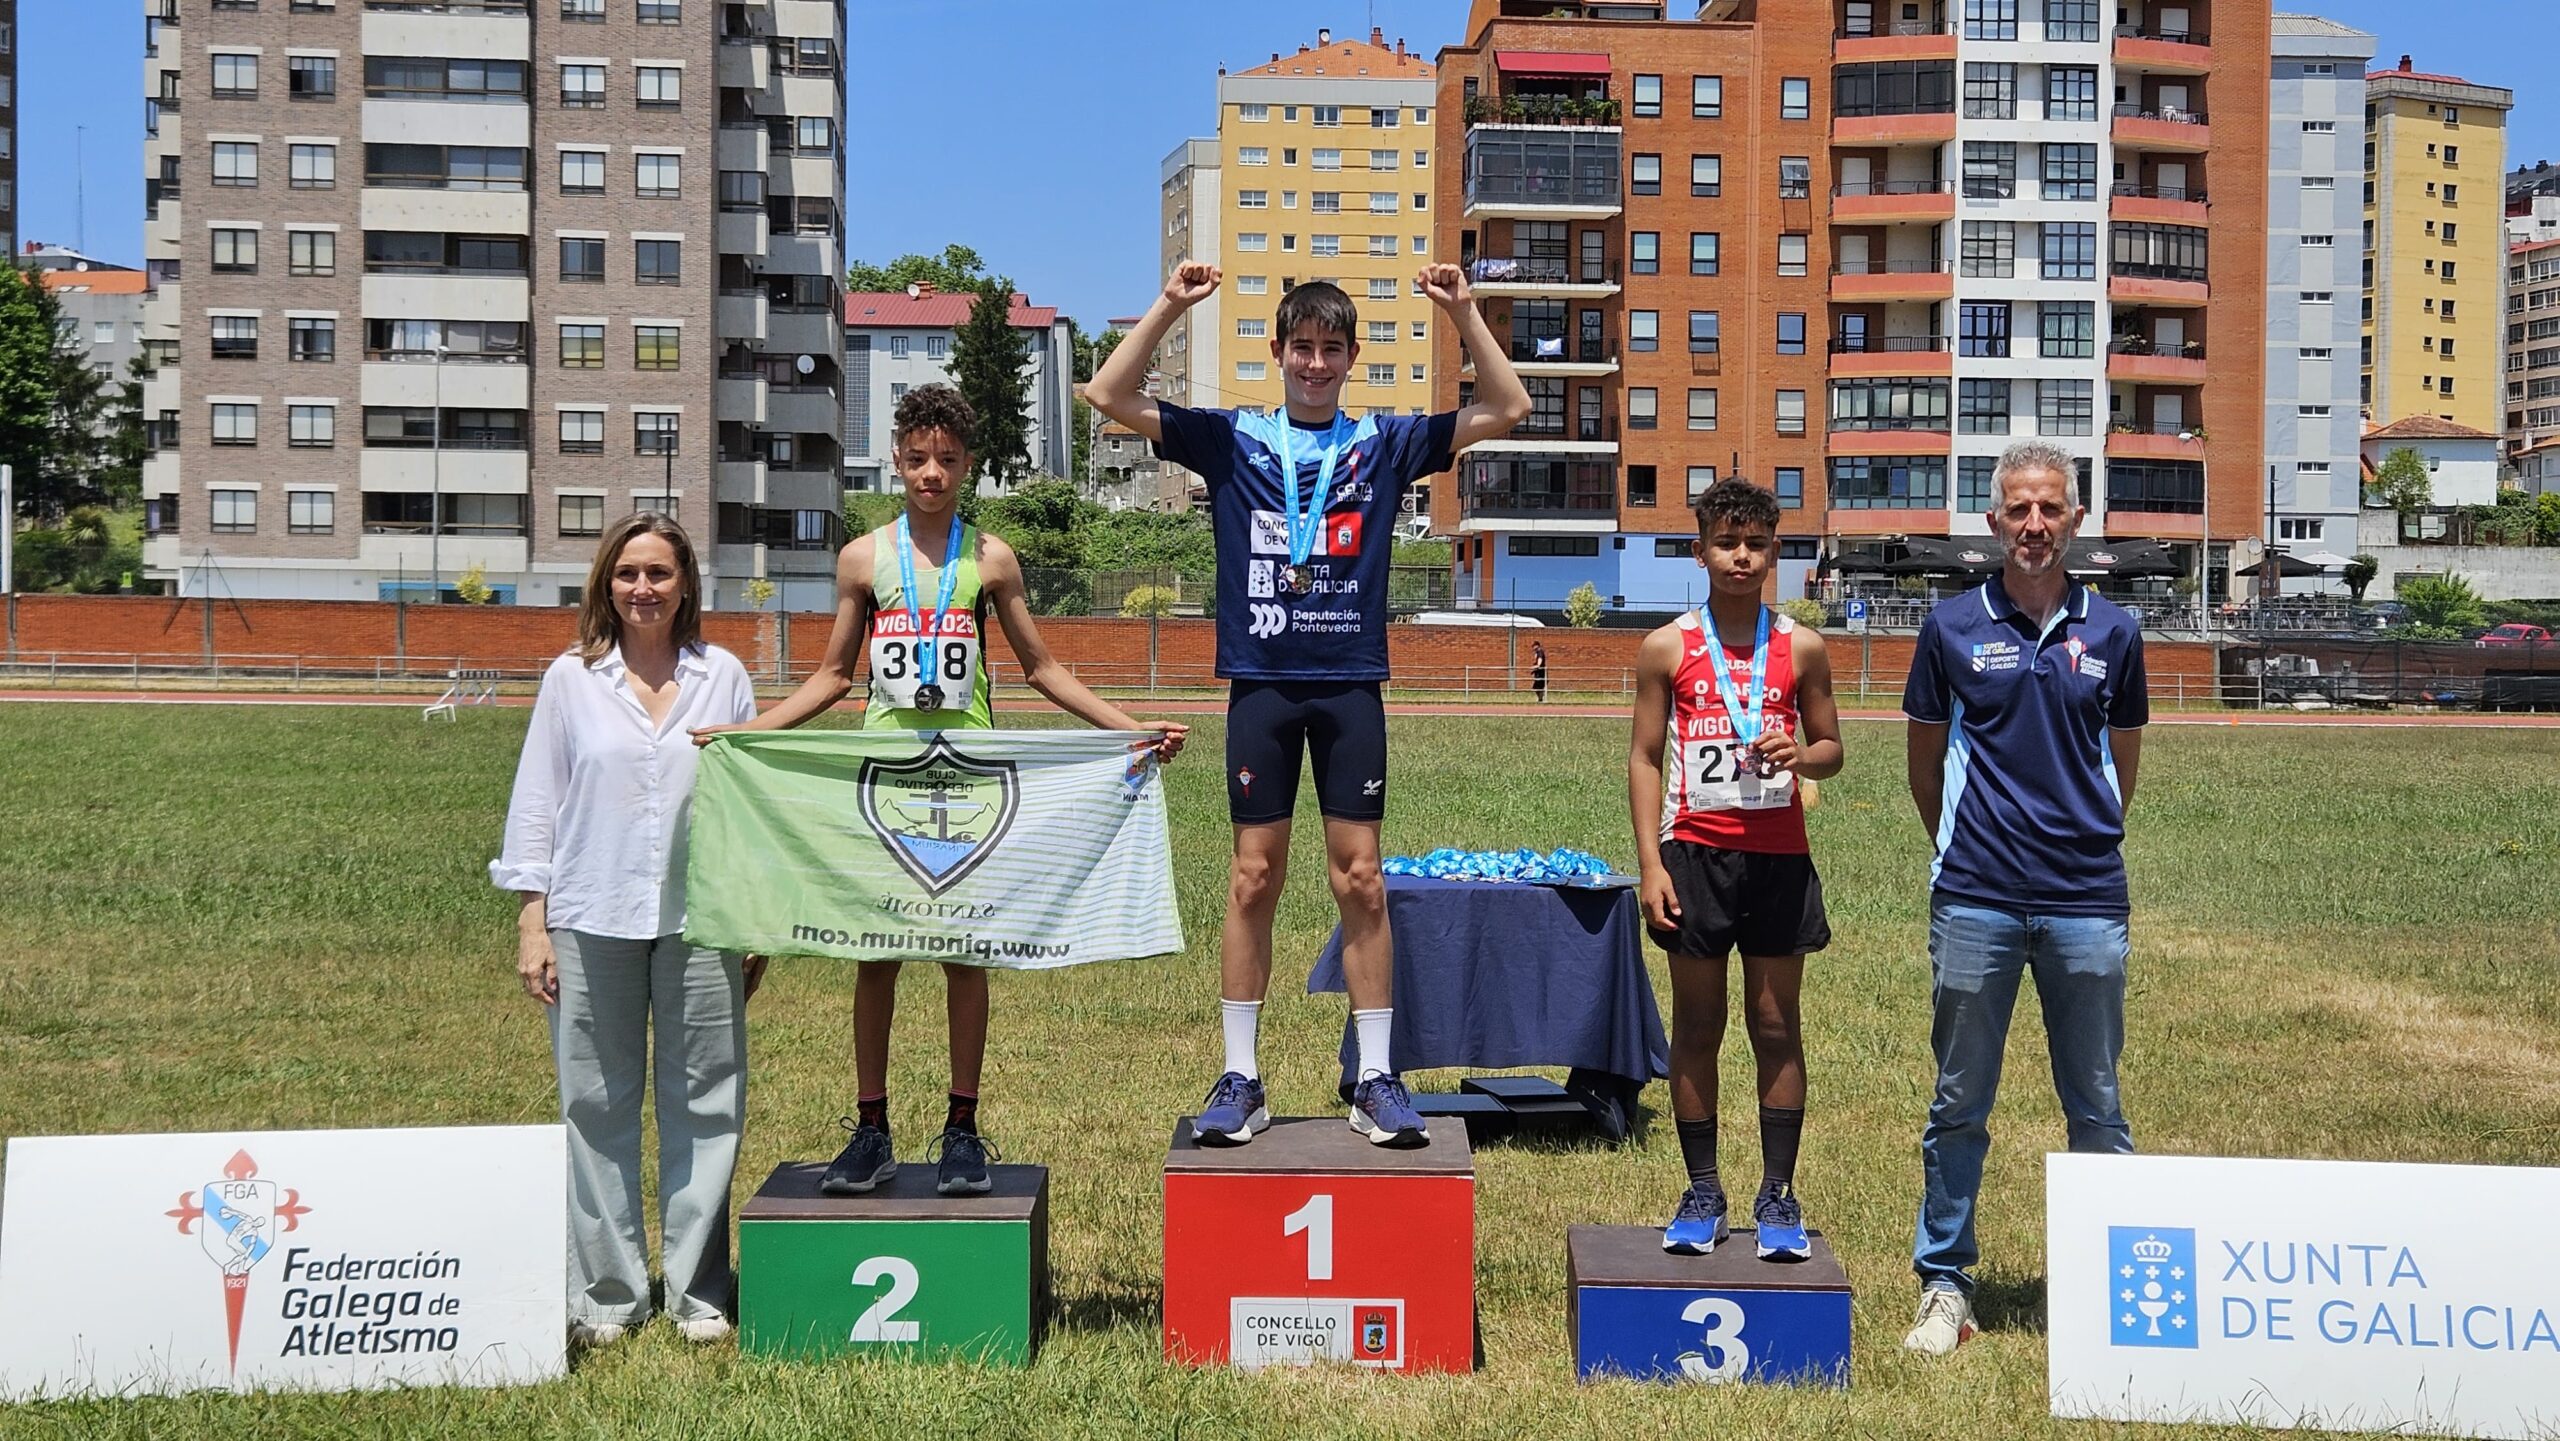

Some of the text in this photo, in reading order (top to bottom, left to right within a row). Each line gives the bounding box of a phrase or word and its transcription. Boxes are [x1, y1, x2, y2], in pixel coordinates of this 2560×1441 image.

[1257, 519, 1288, 531] CONC
[1265, 535, 1278, 546] DE
[1279, 564, 1330, 577] XTA
[1308, 580, 1358, 593] ALICIA
[1293, 609, 1360, 623] Deputación
[1851, 602, 1862, 617] P
[877, 613, 973, 633] VIGO 2025
[1293, 622, 1360, 632] Pontevedra
[1695, 680, 1782, 702] O ARO
[1688, 716, 1732, 737] VIGO
[224, 1183, 259, 1200] FGA
[1284, 1194, 1333, 1280] 1
[282, 1247, 461, 1282] Federación
[2221, 1240, 2428, 1289] XUNTA
[226, 1277, 246, 1289] 1921
[281, 1284, 460, 1326] Galega de
[850, 1256, 919, 1341] 2
[1246, 1316, 1336, 1330] CONCELLO
[2222, 1296, 2560, 1352] DE GALICIA
[280, 1321, 459, 1357] Atletismo
[1257, 1334, 1326, 1347] DE VIGO
[1680, 1297, 1749, 1384] 3
